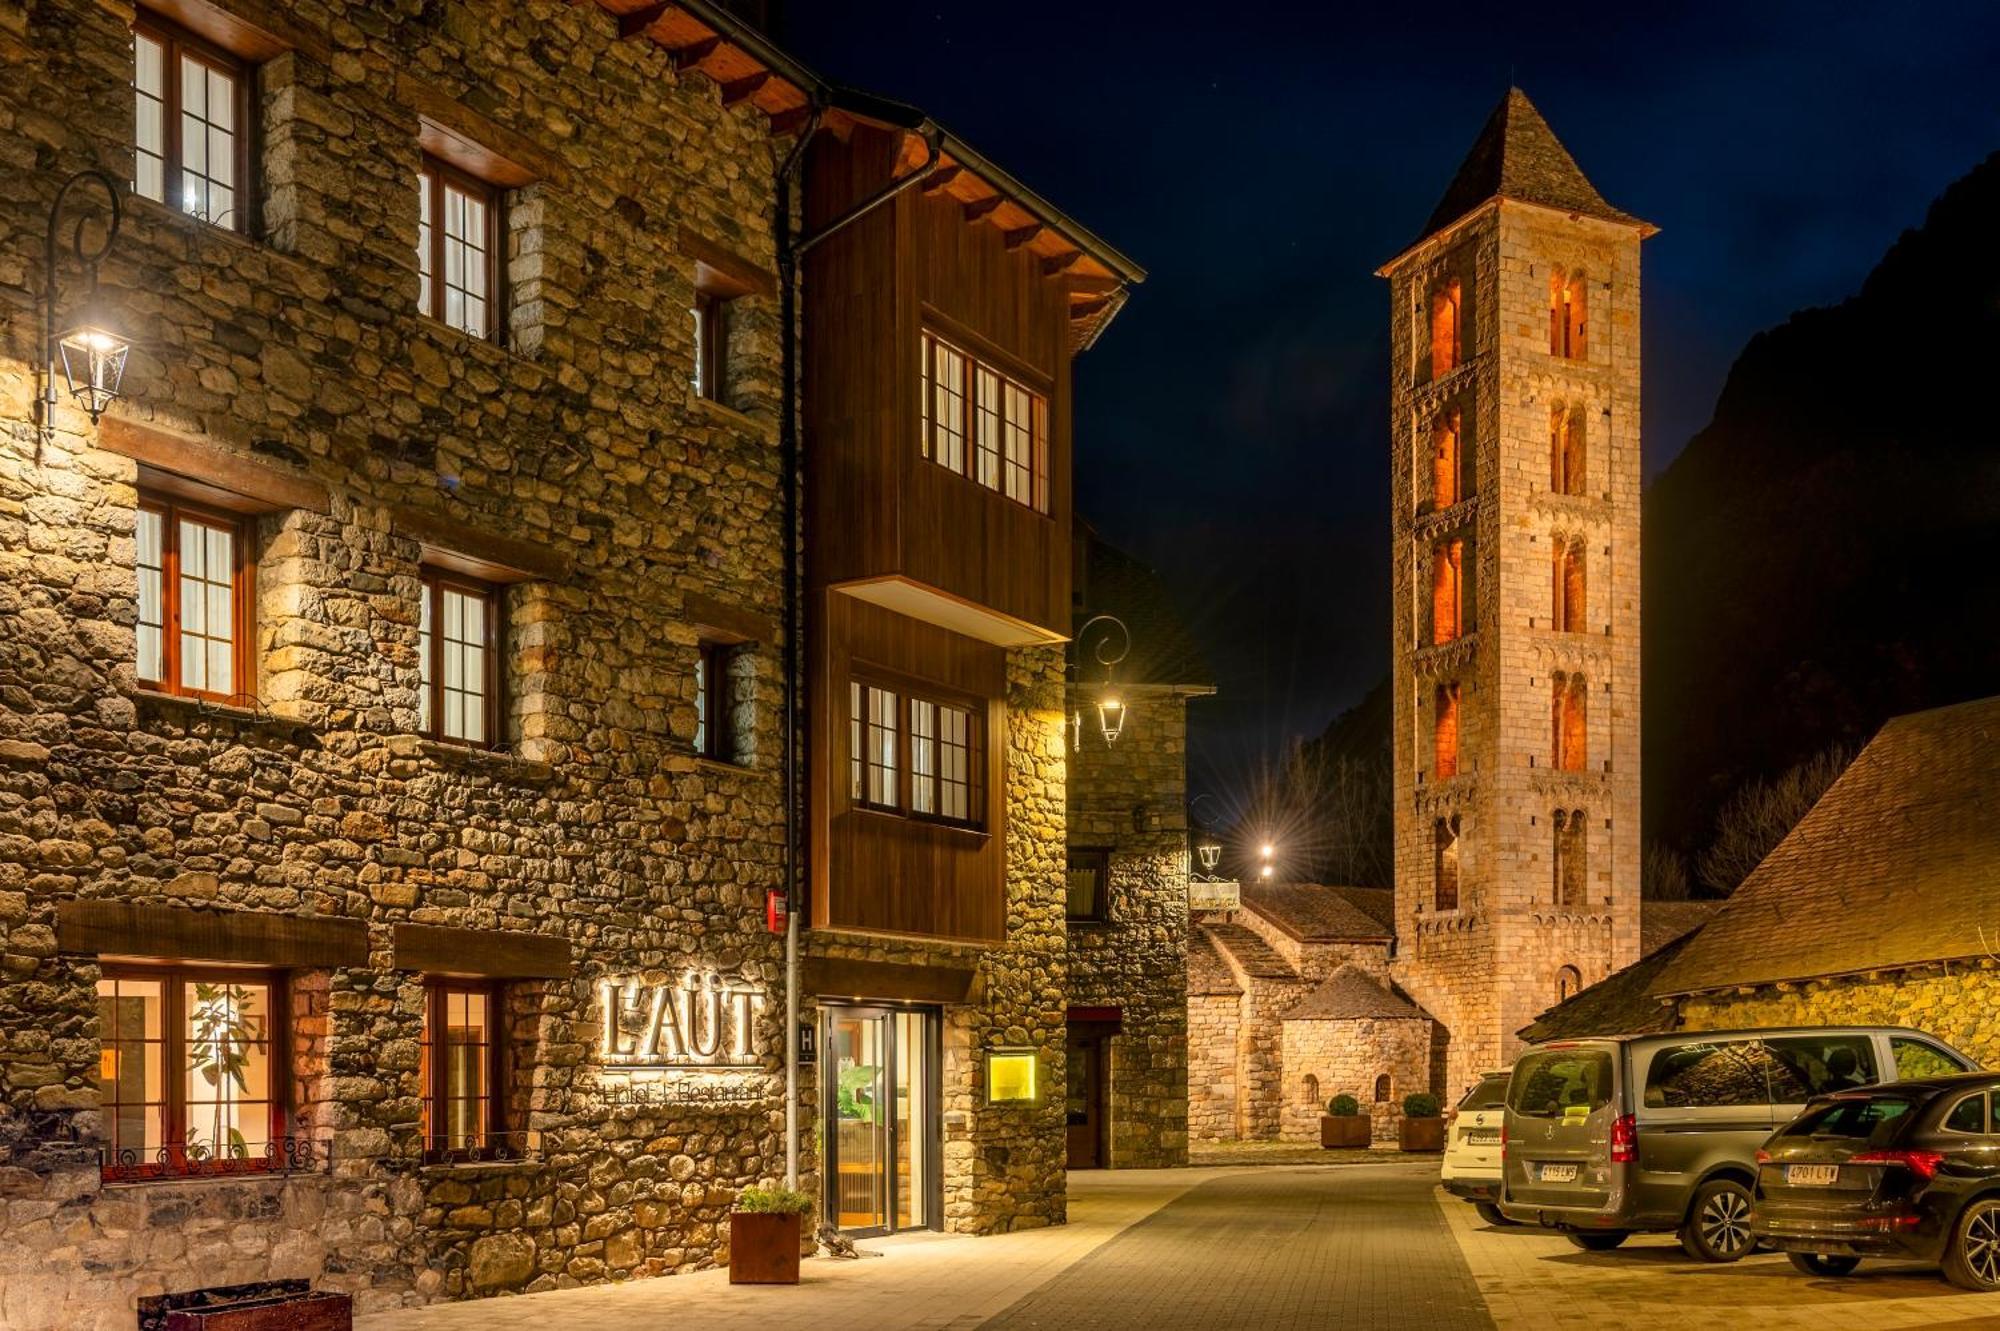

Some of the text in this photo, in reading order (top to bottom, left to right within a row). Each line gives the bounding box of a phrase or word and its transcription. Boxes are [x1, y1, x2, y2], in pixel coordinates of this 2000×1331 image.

[604, 973, 767, 1057] L'AÜT
[802, 1030, 812, 1051] H
[603, 1083, 650, 1104] Hotel
